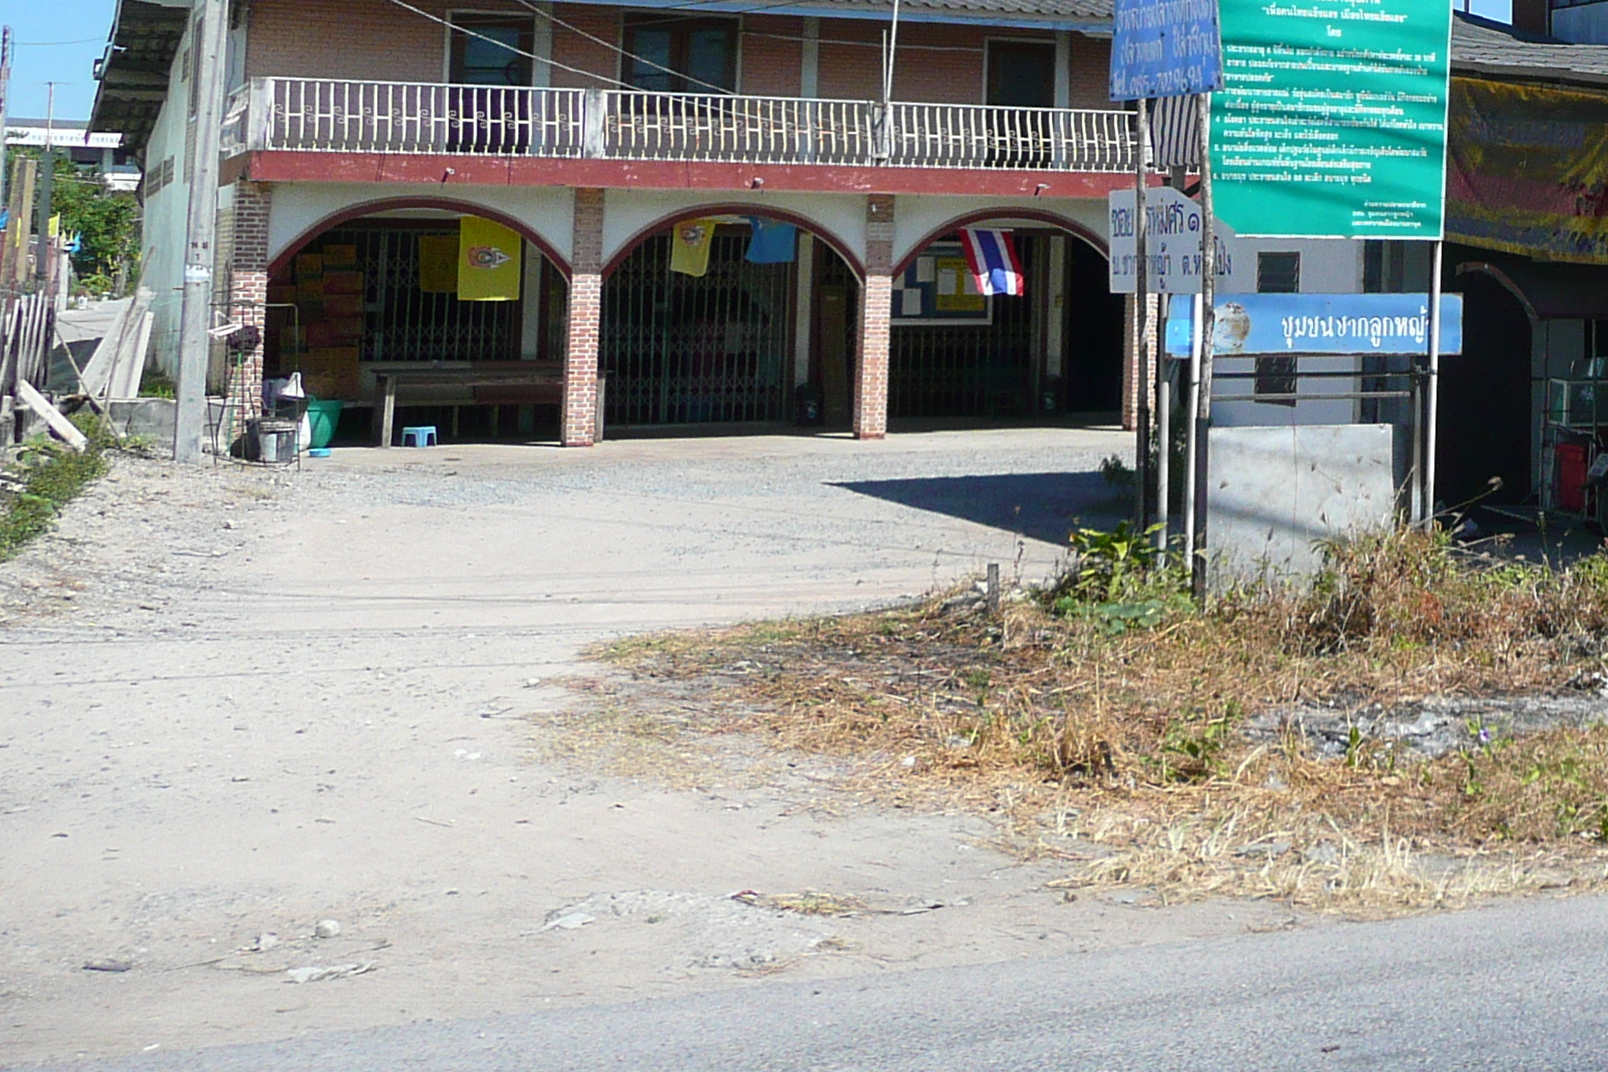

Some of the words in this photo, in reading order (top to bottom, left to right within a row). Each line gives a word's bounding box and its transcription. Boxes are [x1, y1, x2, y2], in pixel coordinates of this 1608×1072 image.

[1281, 304, 1429, 349] ชุมชนชากลูกหญ้
